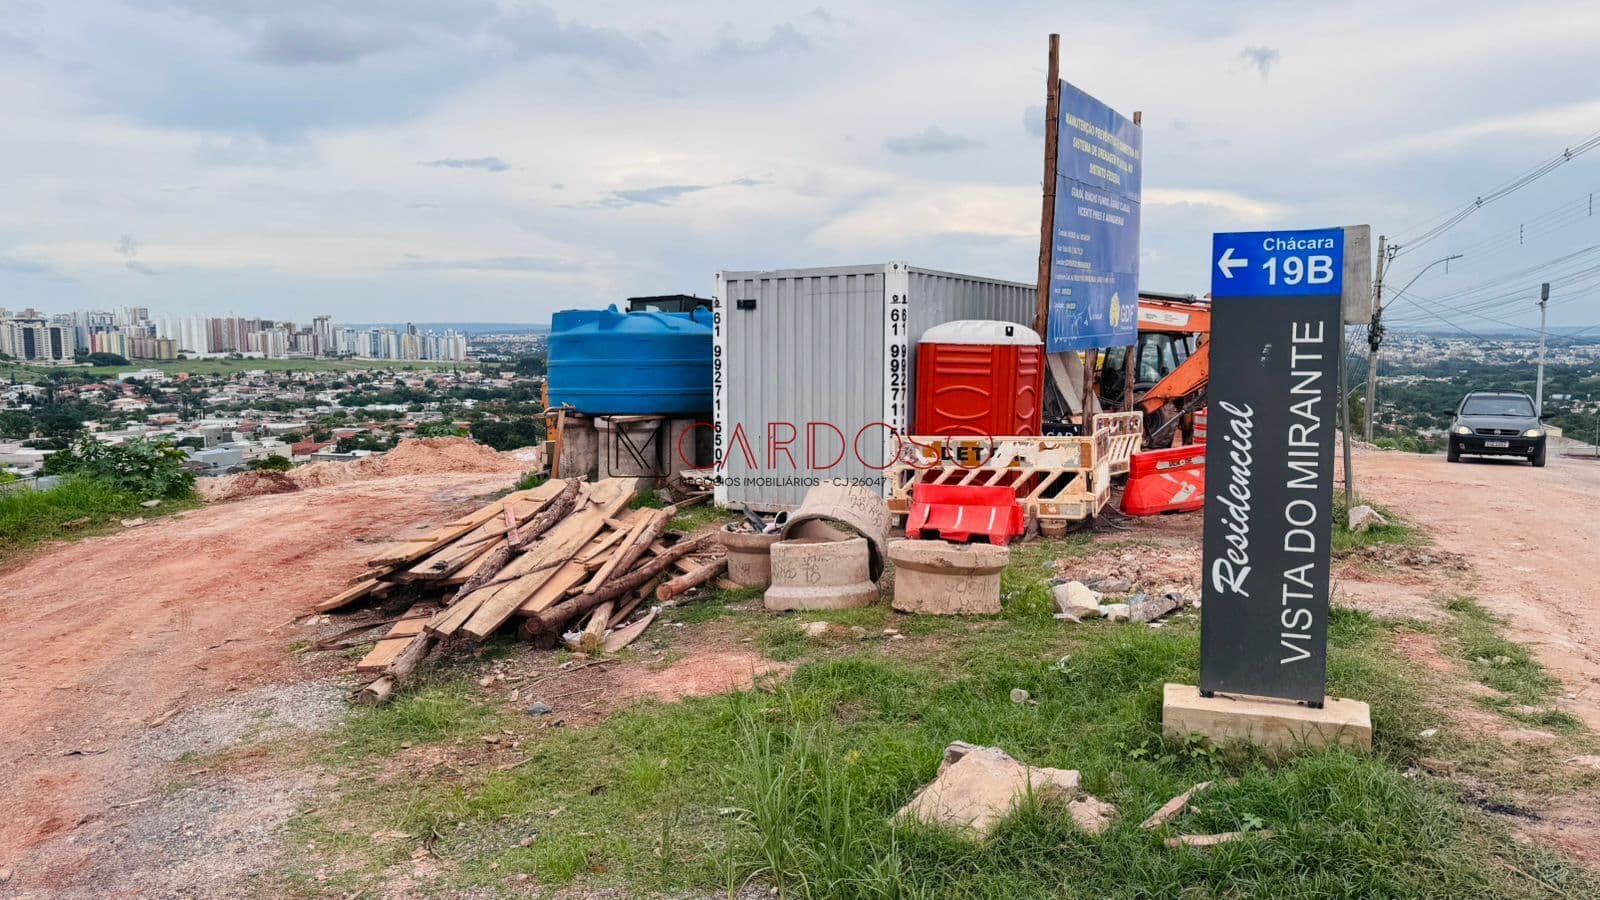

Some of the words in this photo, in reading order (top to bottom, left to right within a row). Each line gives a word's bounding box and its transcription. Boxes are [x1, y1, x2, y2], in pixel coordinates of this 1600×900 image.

[1262, 236, 1335, 252] Chácara
[1262, 255, 1334, 286] 19B
[713, 311, 721, 337] 61
[890, 308, 900, 336] 61
[1286, 320, 1324, 490] MIRANTE
[1212, 400, 1255, 598] Residencial
[1284, 499, 1317, 553] DO
[1280, 563, 1315, 665] VISTA
